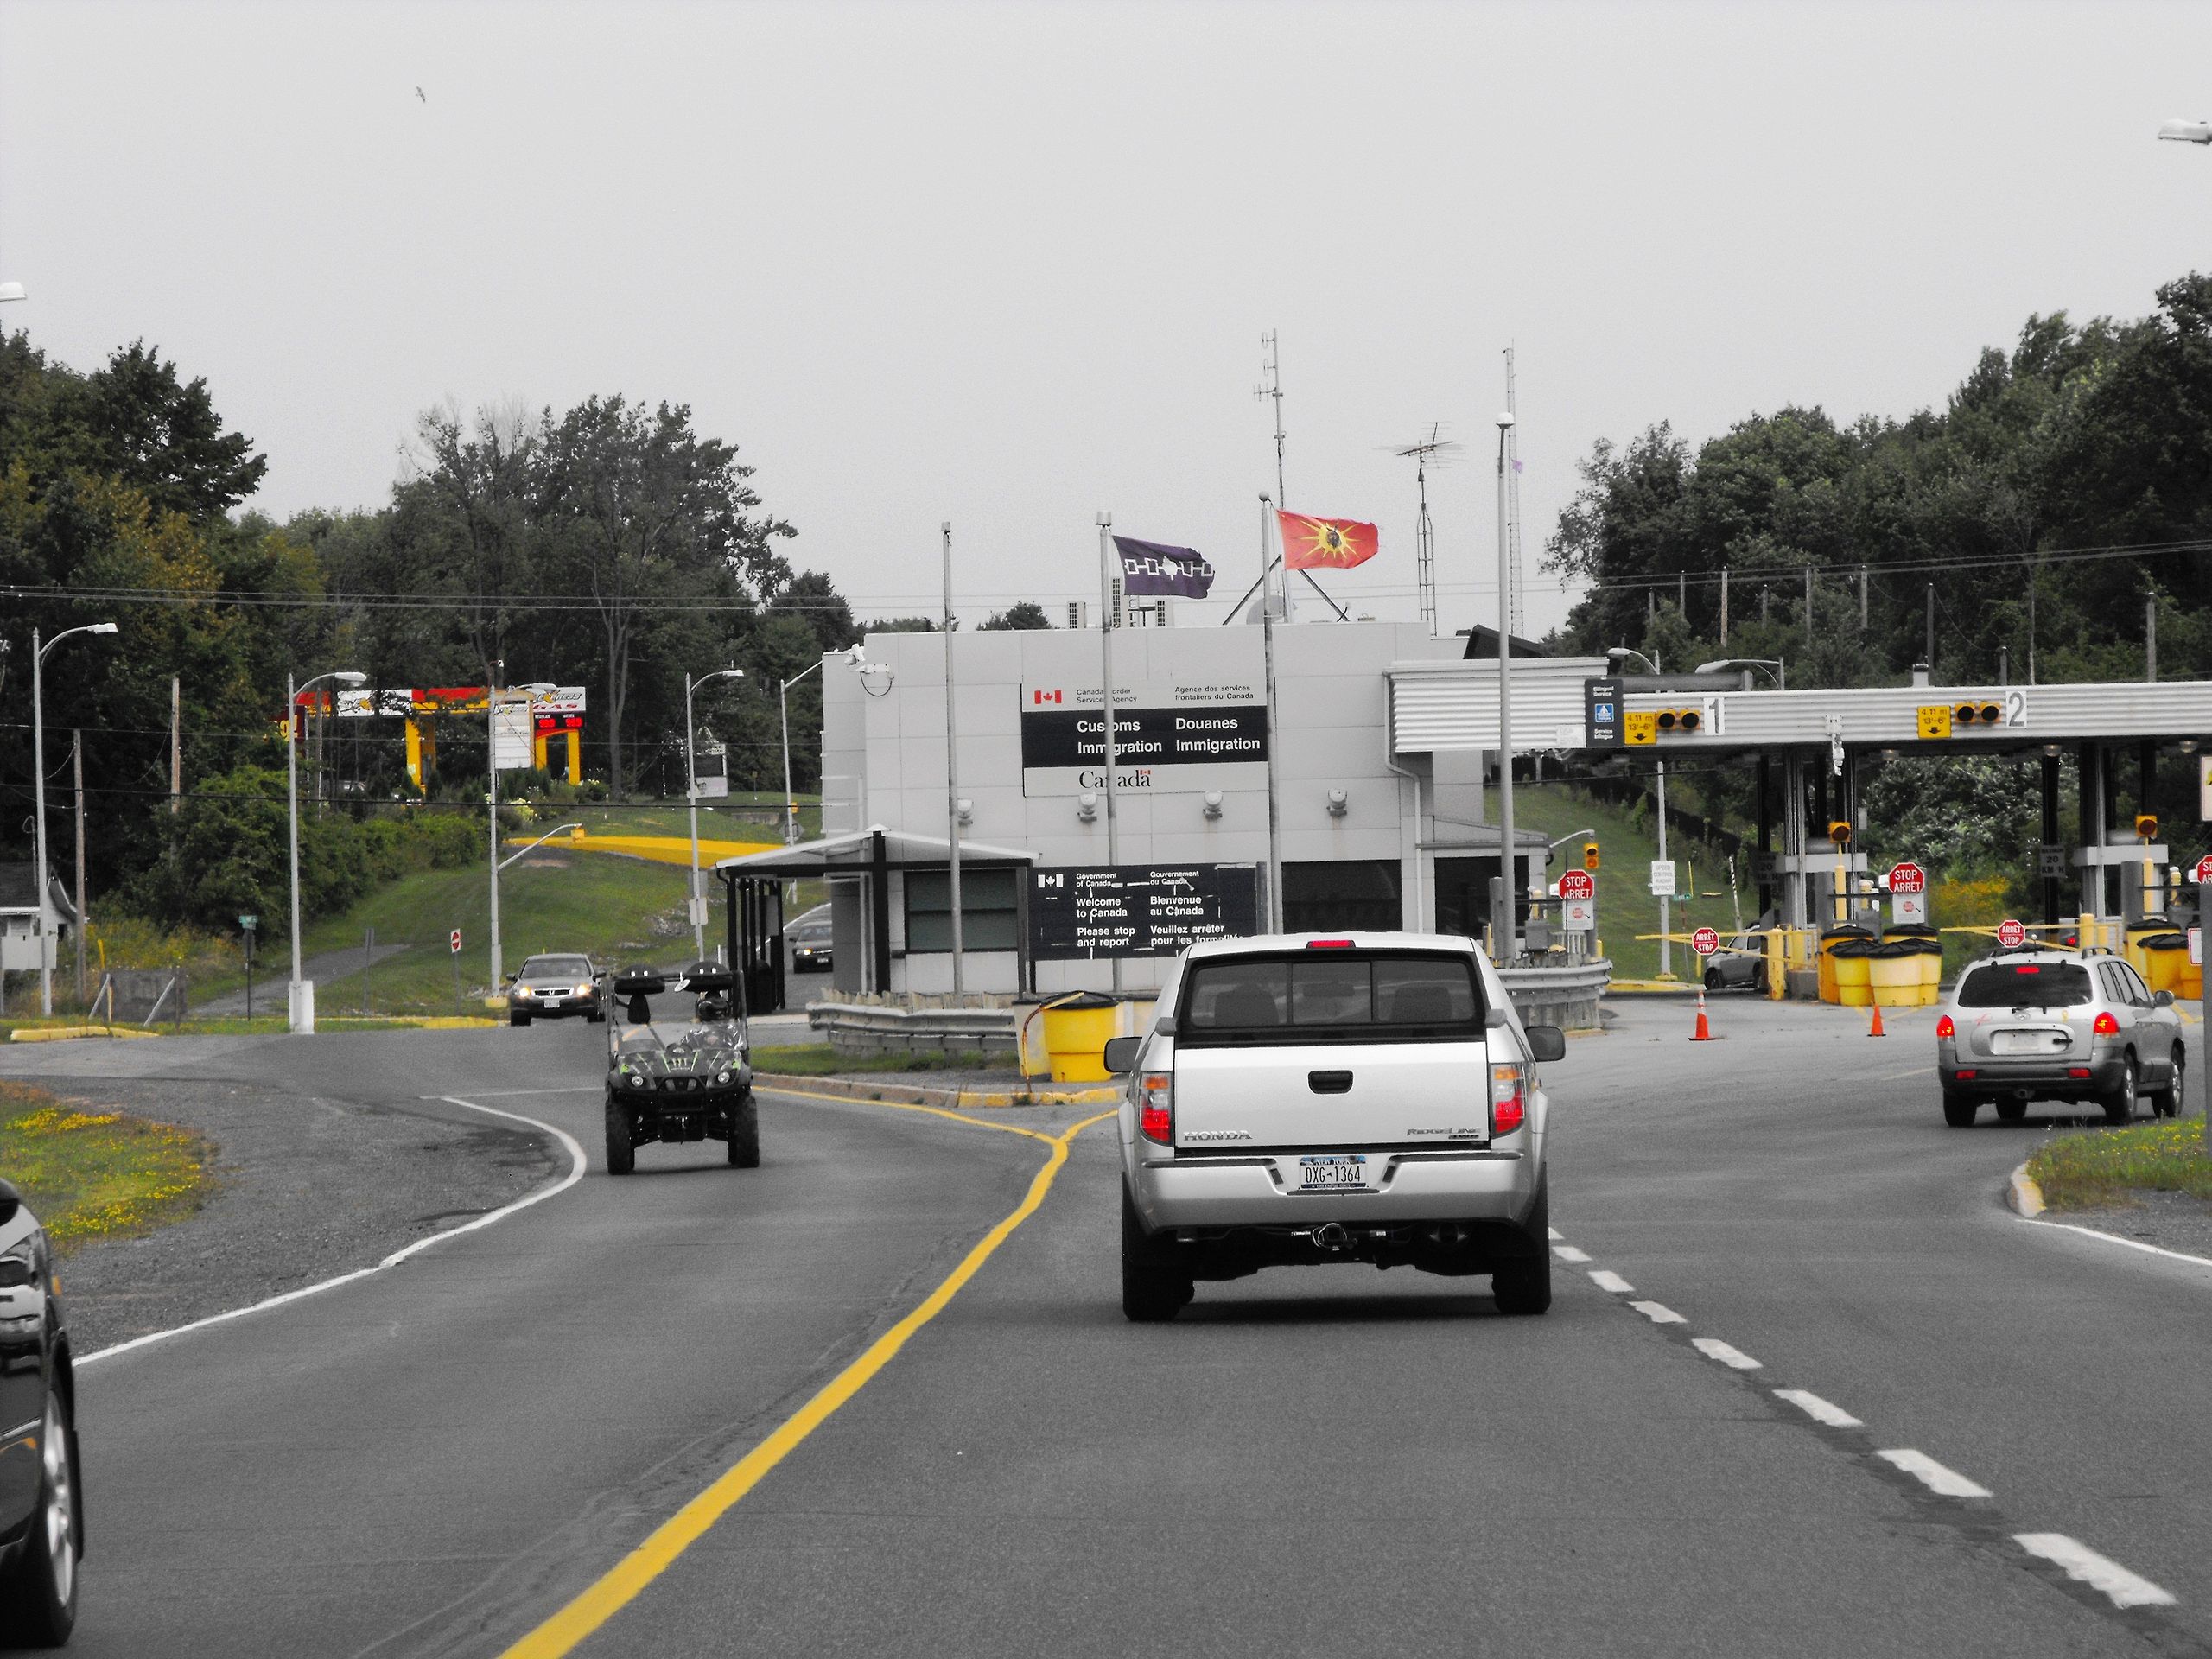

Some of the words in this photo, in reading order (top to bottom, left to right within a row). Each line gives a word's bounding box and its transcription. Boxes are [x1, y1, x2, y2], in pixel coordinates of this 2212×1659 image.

[2009, 691, 2024, 726] 2
[1708, 698, 1719, 734] 1
[1077, 719, 1141, 733] Cusoms
[1176, 717, 1238, 730] Douanes
[1077, 741, 1162, 756] Immgration
[1176, 737, 1261, 753] Immigration
[1078, 769, 1151, 788] Caada
[2046, 855, 2059, 864] 20
[1895, 869, 1917, 880] STOP
[1567, 876, 1587, 887] STOP
[1076, 898, 1122, 907] Welcome
[1150, 895, 1202, 905] Bienvenue
[1076, 909, 1087, 918] to
[1090, 908, 1128, 918] Canada
[1166, 906, 1204, 916] Canada
[1077, 927, 1110, 936] Please
[1114, 926, 1135, 937] stop
[1150, 925, 1188, 934] Veuillez
[1192, 924, 1225, 933] arrêter
[1077, 937, 1096, 947] and
[1099, 937, 1130, 948] report
[1151, 937, 1174, 947] pour
[1177, 935, 1192, 944] les
[1698, 944, 1714, 952] STOP
[1183, 1129, 1253, 1141] HONDA
